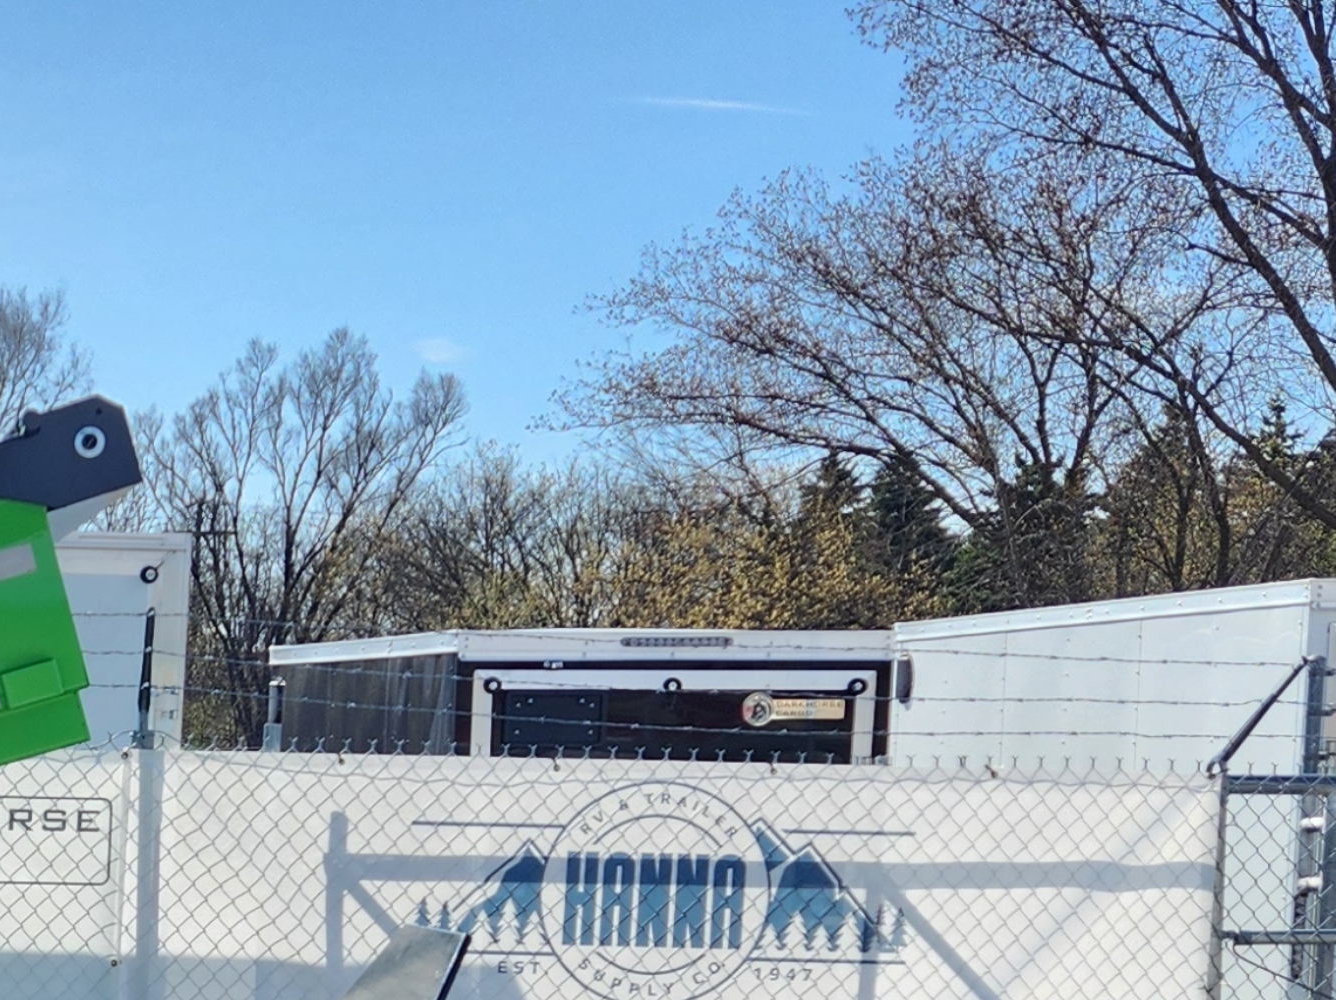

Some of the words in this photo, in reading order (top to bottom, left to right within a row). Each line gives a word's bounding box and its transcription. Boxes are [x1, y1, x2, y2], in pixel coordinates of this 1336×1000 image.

[579, 811, 605, 835] RV
[644, 793, 738, 838] TRAILER
[562, 851, 747, 950] HANNA
[498, 959, 549, 976] EST.
[578, 957, 674, 996] SUPPLY
[754, 966, 813, 982] 1947
